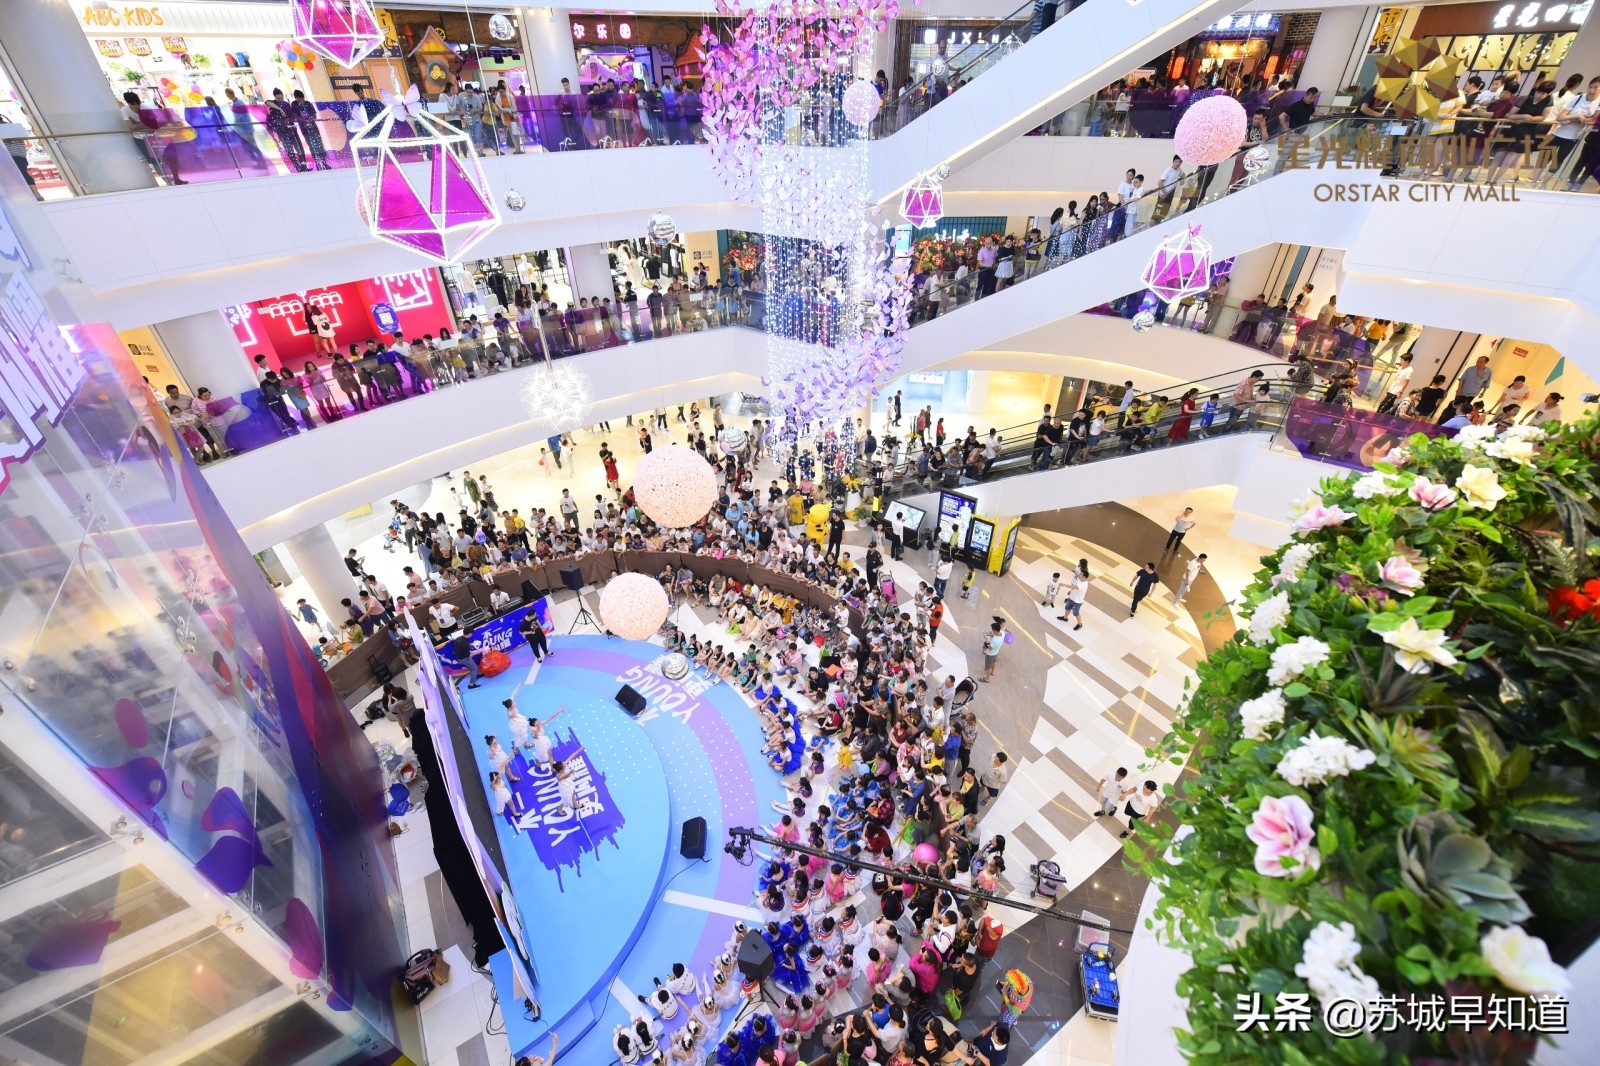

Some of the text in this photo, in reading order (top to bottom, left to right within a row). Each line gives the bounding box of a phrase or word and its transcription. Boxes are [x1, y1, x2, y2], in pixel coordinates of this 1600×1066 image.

[83, 6, 164, 26] ABC KIDS
[526, 762, 581, 847] YOUNG
